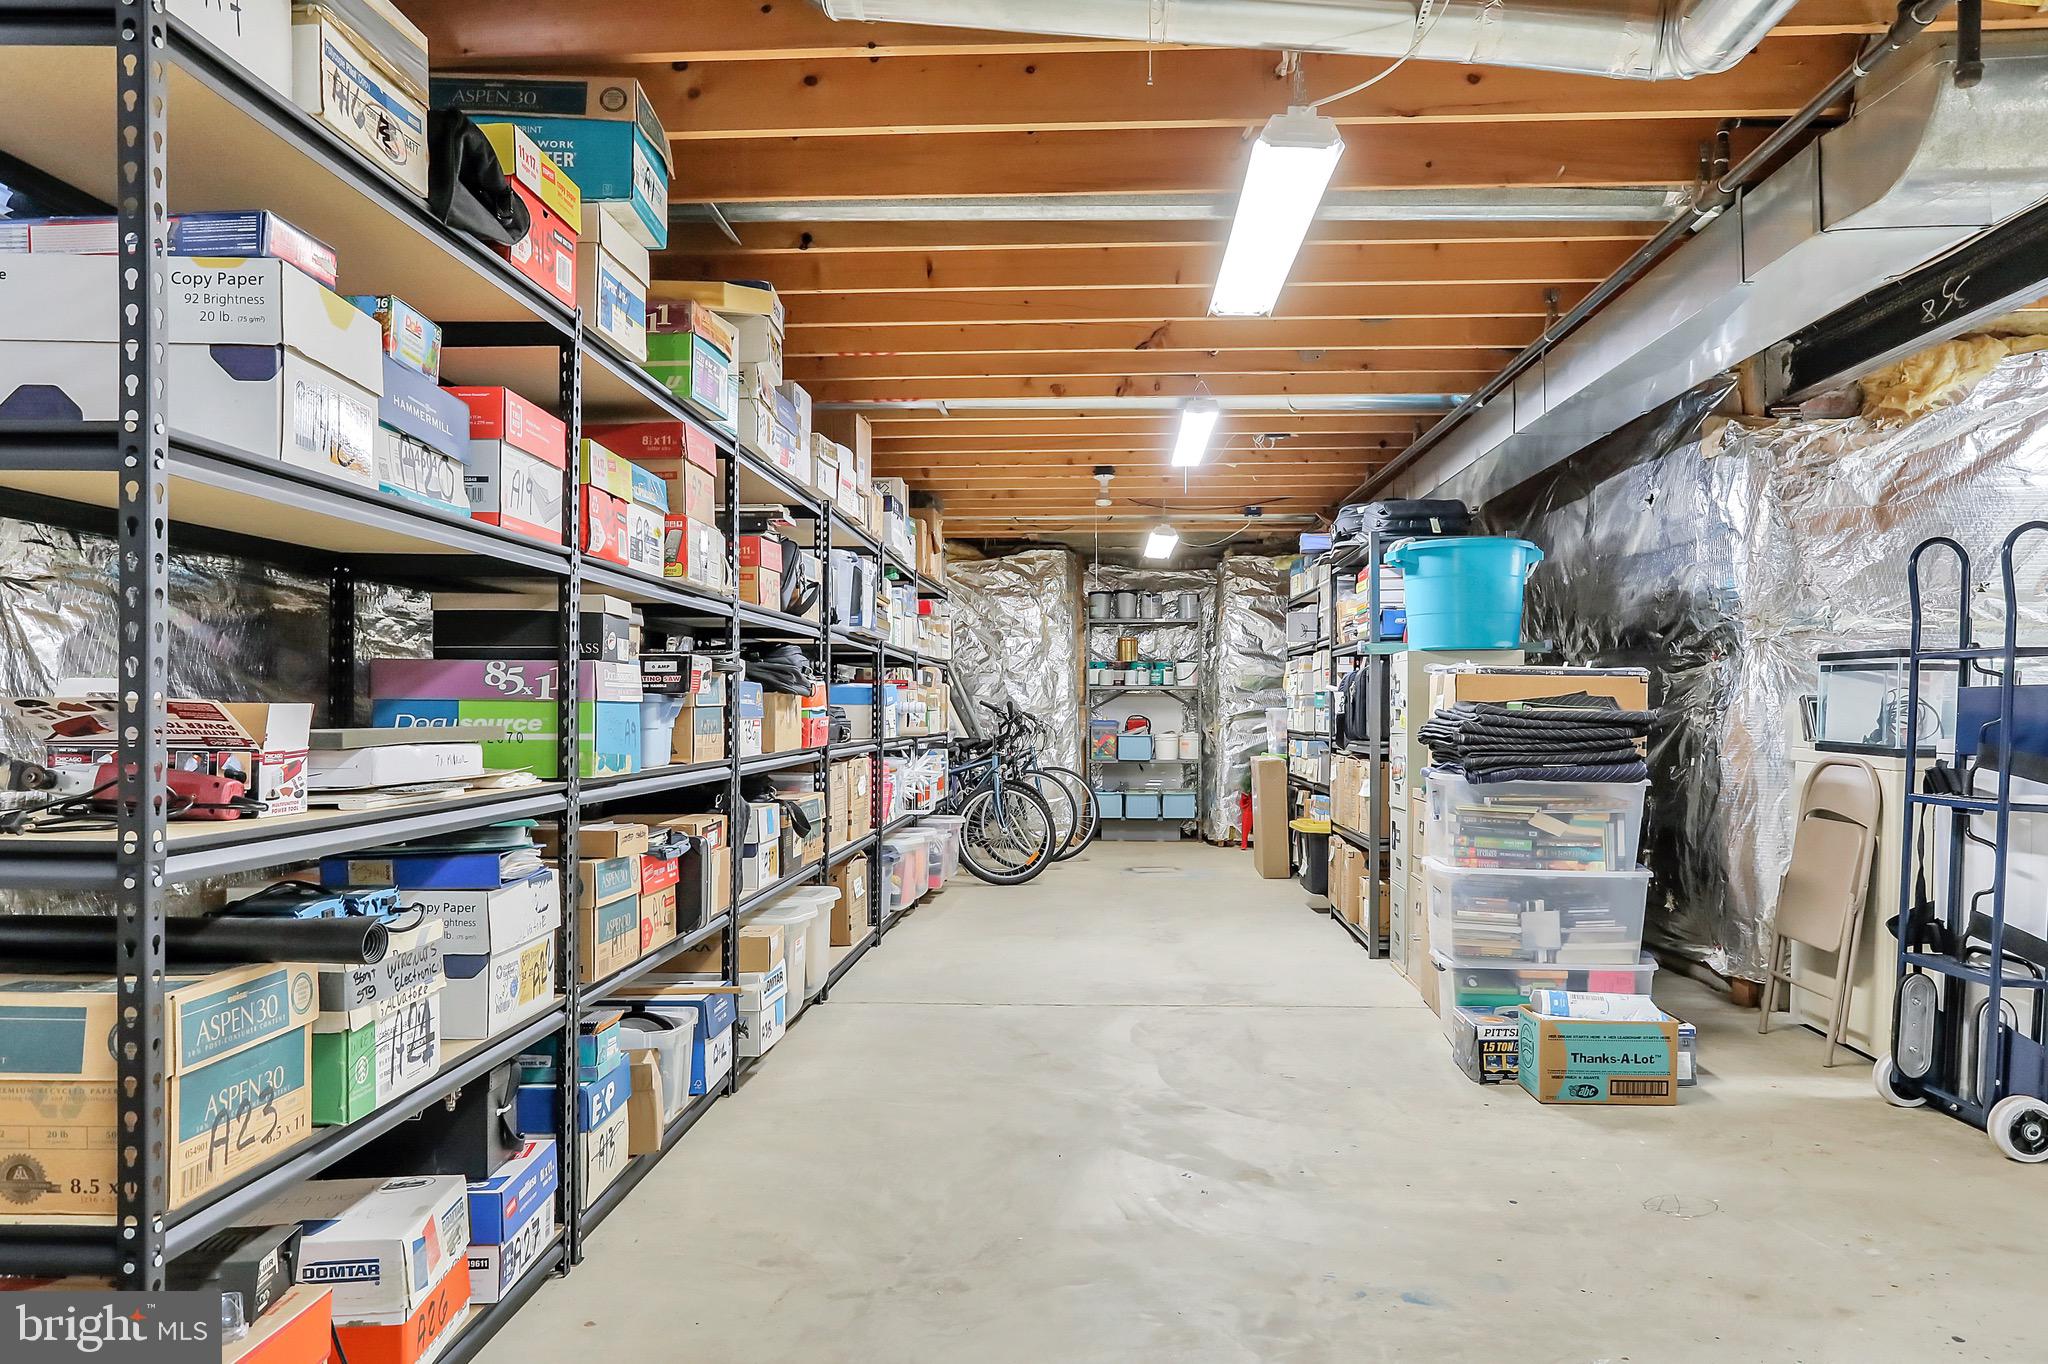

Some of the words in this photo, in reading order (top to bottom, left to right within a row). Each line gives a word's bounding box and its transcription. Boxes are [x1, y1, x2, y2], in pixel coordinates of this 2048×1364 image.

[452, 89, 511, 104] ASPEN
[513, 91, 537, 105] 30
[537, 140, 574, 149] WORK
[171, 271, 212, 289] Copy
[217, 271, 265, 288] Paper
[184, 293, 199, 305] 92
[203, 292, 265, 306] Brightness
[375, 297, 389, 308] 16
[200, 311, 215, 323] 20
[219, 310, 233, 323] lb.
[393, 394, 454, 437] HAMMERMILL
[662, 675, 681, 683] SAW
[411, 901, 441, 915] Copy
[443, 902, 477, 915] Paper
[442, 917, 477, 929] ghtness
[443, 930, 454, 940] lb.
[196, 1001, 255, 1047] ASPEN
[257, 994, 278, 1024] 30
[259, 1014, 286, 1030] CONTENT
[1484, 1028, 1519, 1037] PITTS
[1483, 1042, 1495, 1052] 1.5
[1496, 1042, 1513, 1052] TON
[204, 1074, 262, 1122] ASPEN
[265, 1065, 284, 1090] 30
[1578, 1086, 1595, 1097] abc
[592, 1080, 615, 1127] EXP
[208, 1084, 278, 1173] A23
[294, 1113, 305, 1130] 11
[70, 1178, 100, 1195] 8.5
[302, 1263, 380, 1280] DOMTAR
[417, 1288, 448, 1350] A26
